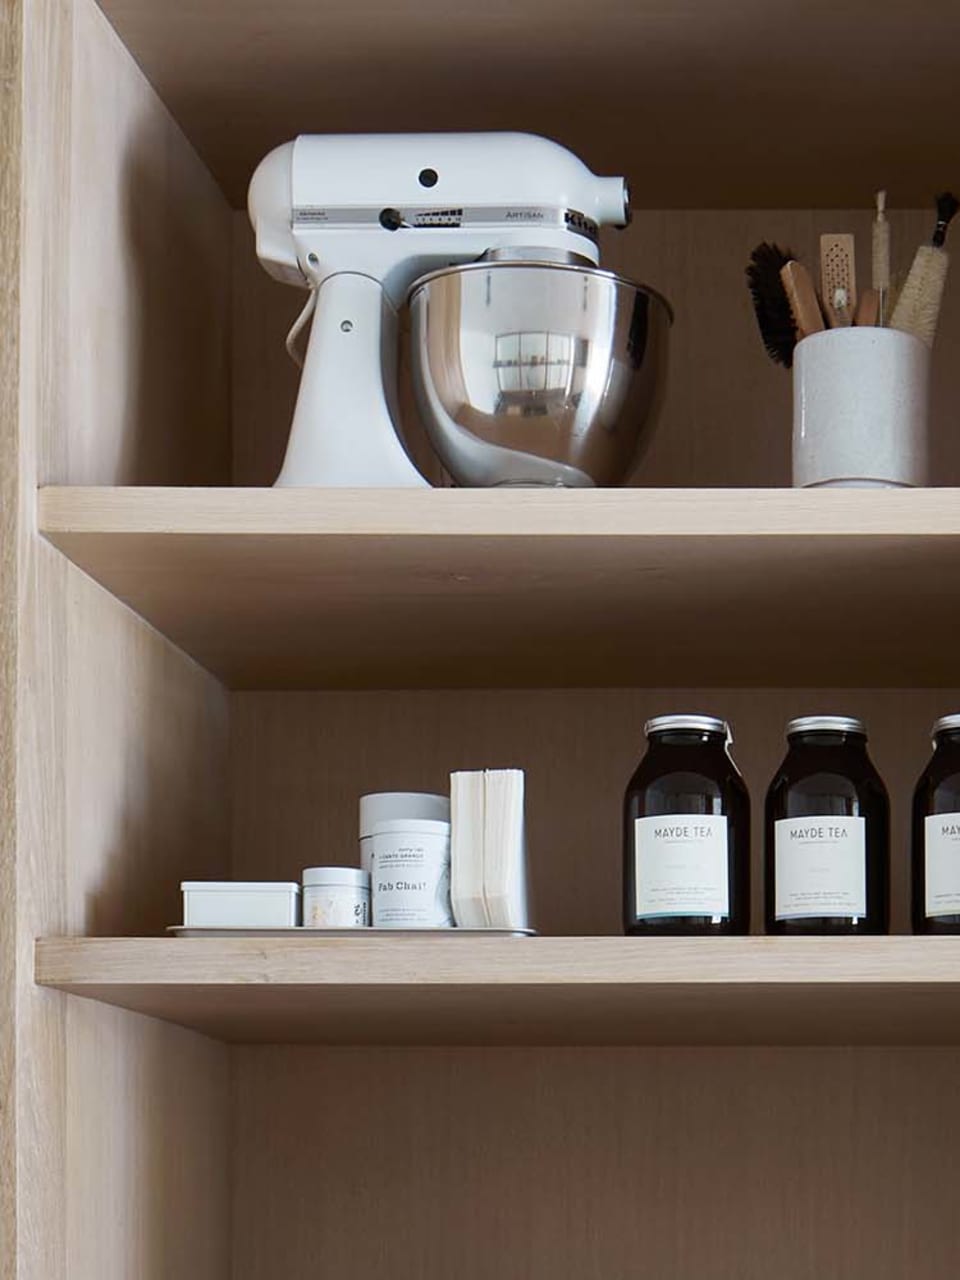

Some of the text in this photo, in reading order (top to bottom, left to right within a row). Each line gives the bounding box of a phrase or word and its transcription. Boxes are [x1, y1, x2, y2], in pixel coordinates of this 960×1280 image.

[654, 826, 713, 838] MAYDE TEA
[790, 827, 849, 840] MAYDE TEA
